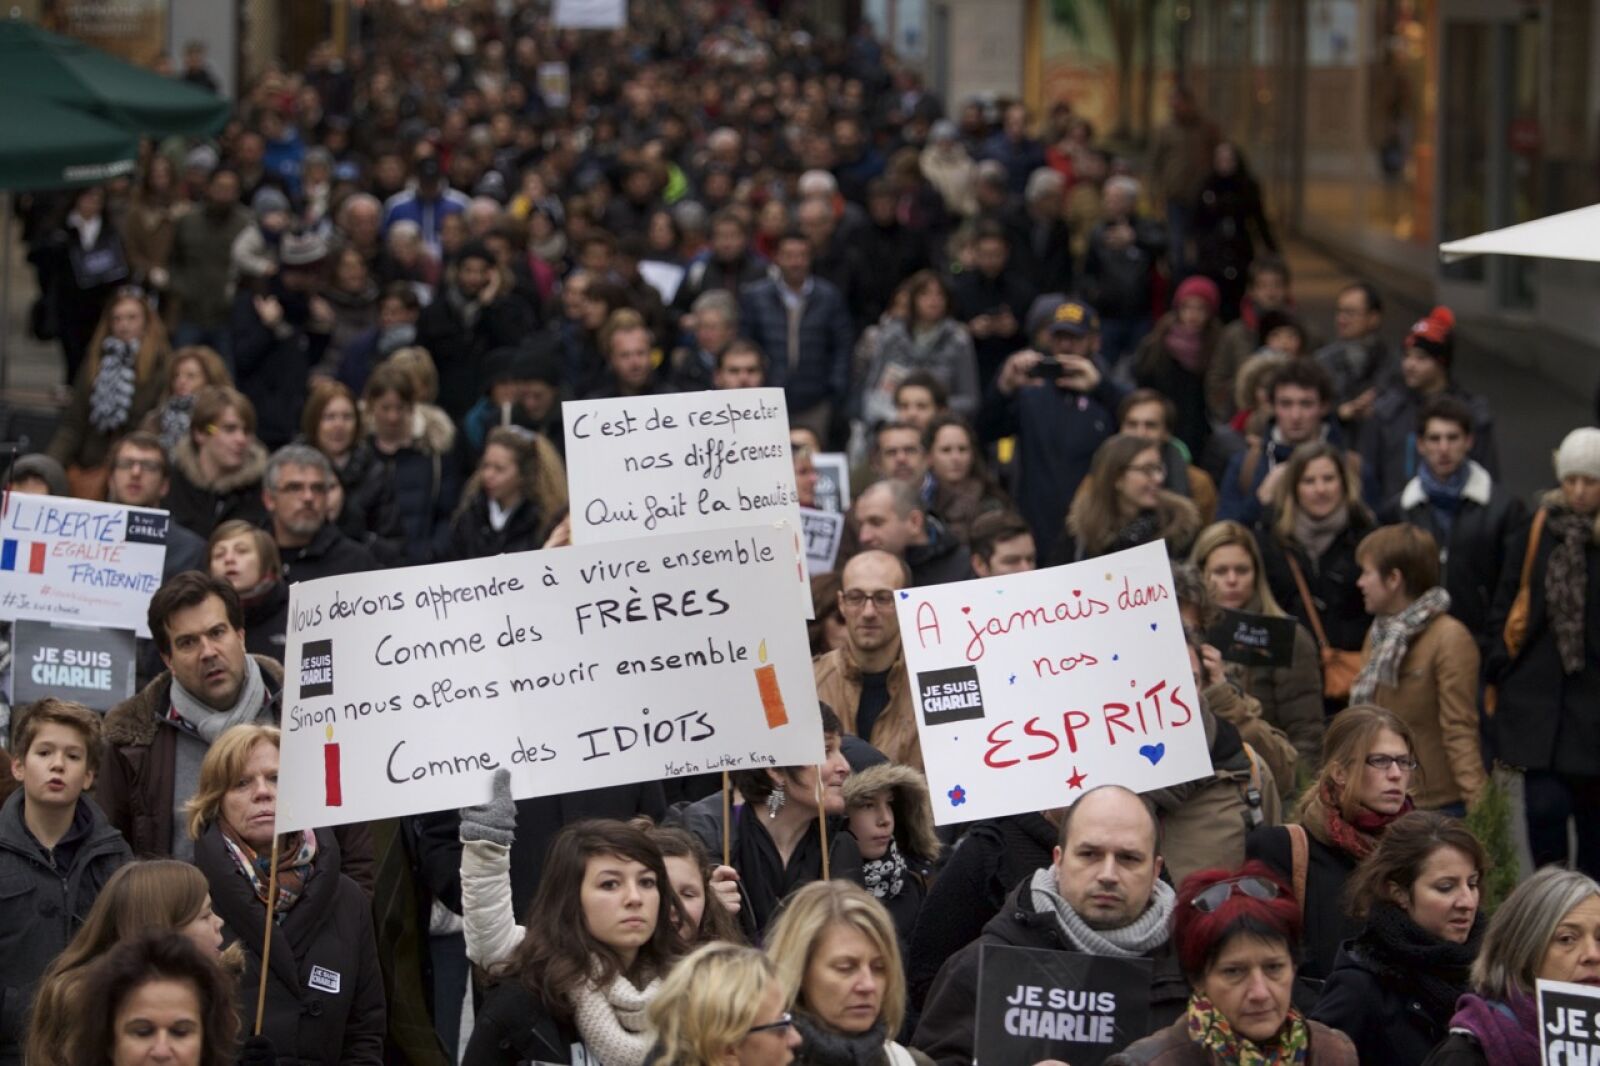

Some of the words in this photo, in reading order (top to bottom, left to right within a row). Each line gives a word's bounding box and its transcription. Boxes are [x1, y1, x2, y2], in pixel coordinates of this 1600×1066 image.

[573, 410, 637, 438] C'est
[645, 407, 678, 430] de
[688, 398, 778, 433] respecter
[625, 453, 673, 472] nos
[684, 438, 782, 479] différences
[585, 498, 638, 525] Qui
[645, 492, 685, 530] fait
[698, 488, 730, 515] la
[415, 576, 524, 620] apprendre
[542, 566, 559, 587] à
[580, 560, 650, 583] vivre
[662, 538, 775, 569] ensemble
[375, 632, 485, 666] Comme
[497, 614, 542, 647] des
[575, 586, 730, 635] FRÈRES
[962, 590, 1110, 661] jamais
[1118, 576, 1168, 610] dans
[32, 646, 60, 664] JE
[63, 648, 112, 668] SUIS
[310, 654, 331, 668] SUIS
[1033, 653, 1098, 677] nos
[31, 663, 112, 690] CHARLIE
[290, 705, 336, 732] Sinon
[344, 695, 402, 720] nous
[413, 678, 499, 708] allons
[510, 661, 599, 692] mourir
[616, 637, 748, 675] ensemble
[300, 667, 332, 686] CHARLIE
[923, 685, 941, 697] JE
[943, 680, 978, 695] SUIS
[924, 691, 981, 713] CHARLIE
[386, 740, 500, 784] Comme
[511, 736, 557, 764] des
[665, 761, 699, 776] Martin
[749, 751, 776, 765] King
[1006, 985, 1043, 1007] JE
[1048, 988, 1116, 1013] SUIS
[1004, 1007, 1115, 1043] CHARLIE
[1546, 1006, 1589, 1038] JE
